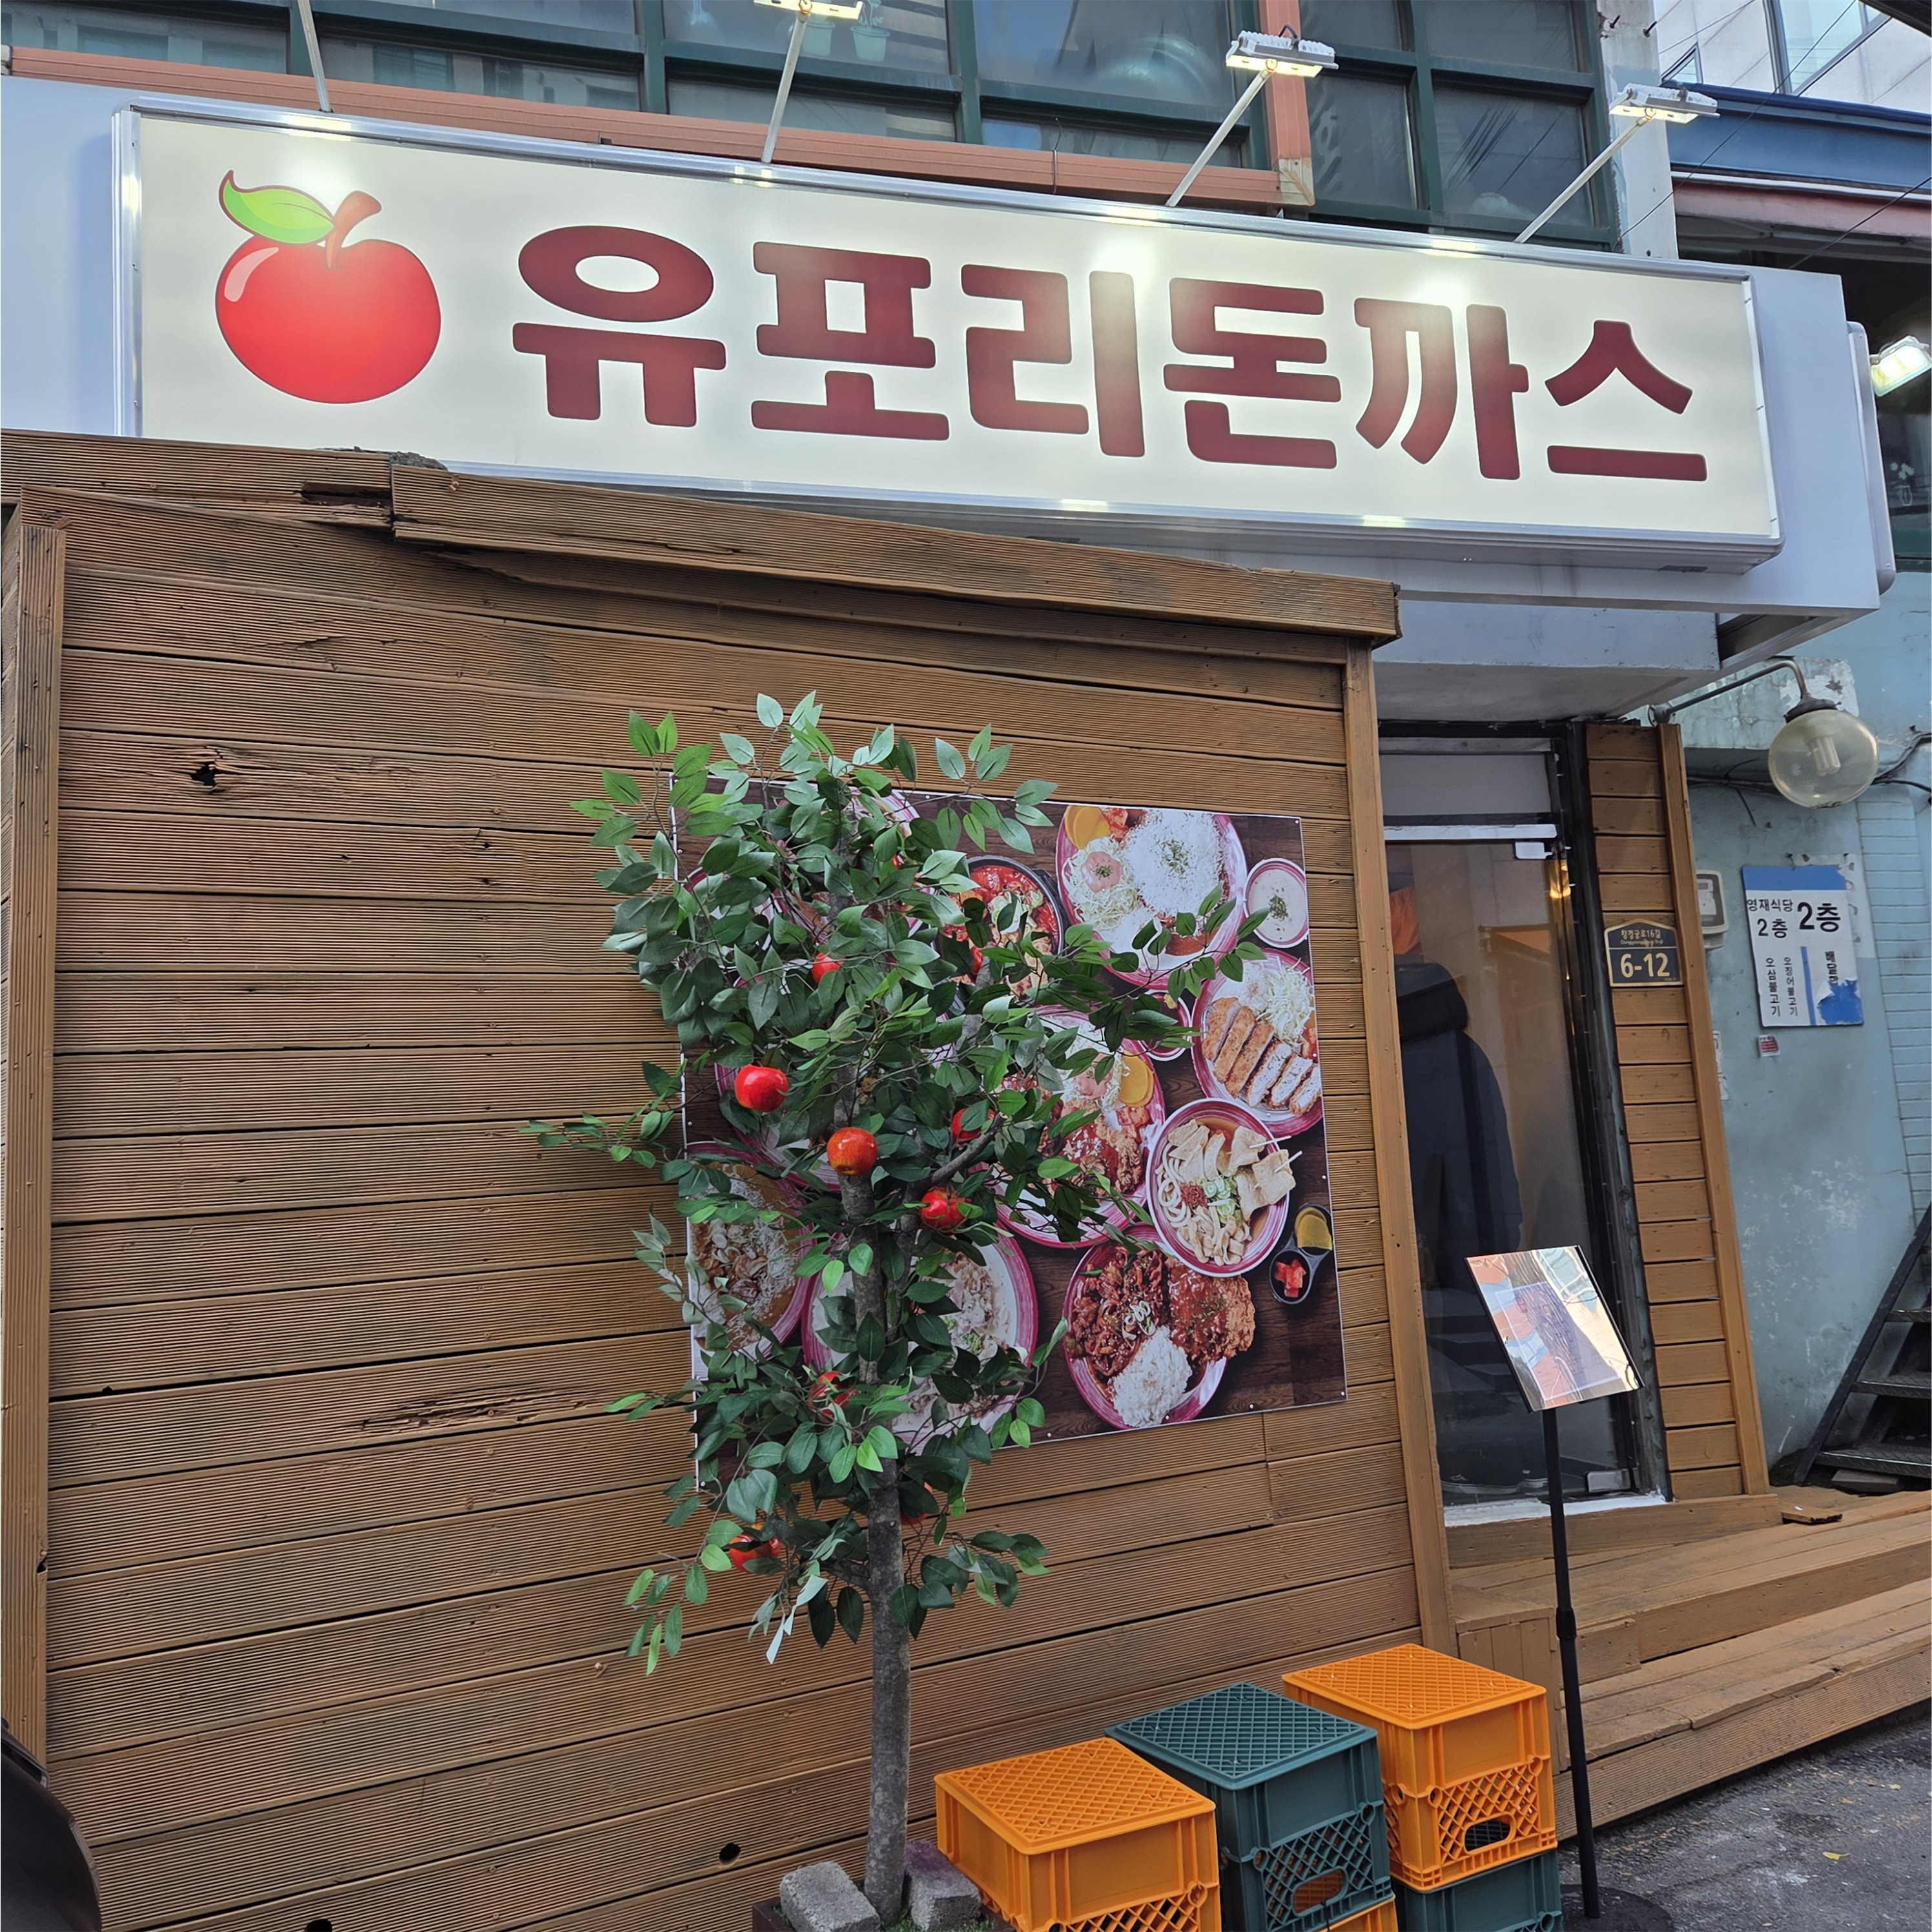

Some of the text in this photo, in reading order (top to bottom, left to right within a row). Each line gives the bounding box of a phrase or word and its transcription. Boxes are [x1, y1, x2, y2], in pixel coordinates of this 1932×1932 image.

[512, 225, 1707, 482] 유포리돈까스
[1747, 898, 1793, 912] 영재식당
[1797, 901, 1841, 932] 2층
[1757, 918, 1788, 938] 2층
[1621, 952, 1670, 978] 6-12
[1765, 958, 1781, 1017] 오삼불고기
